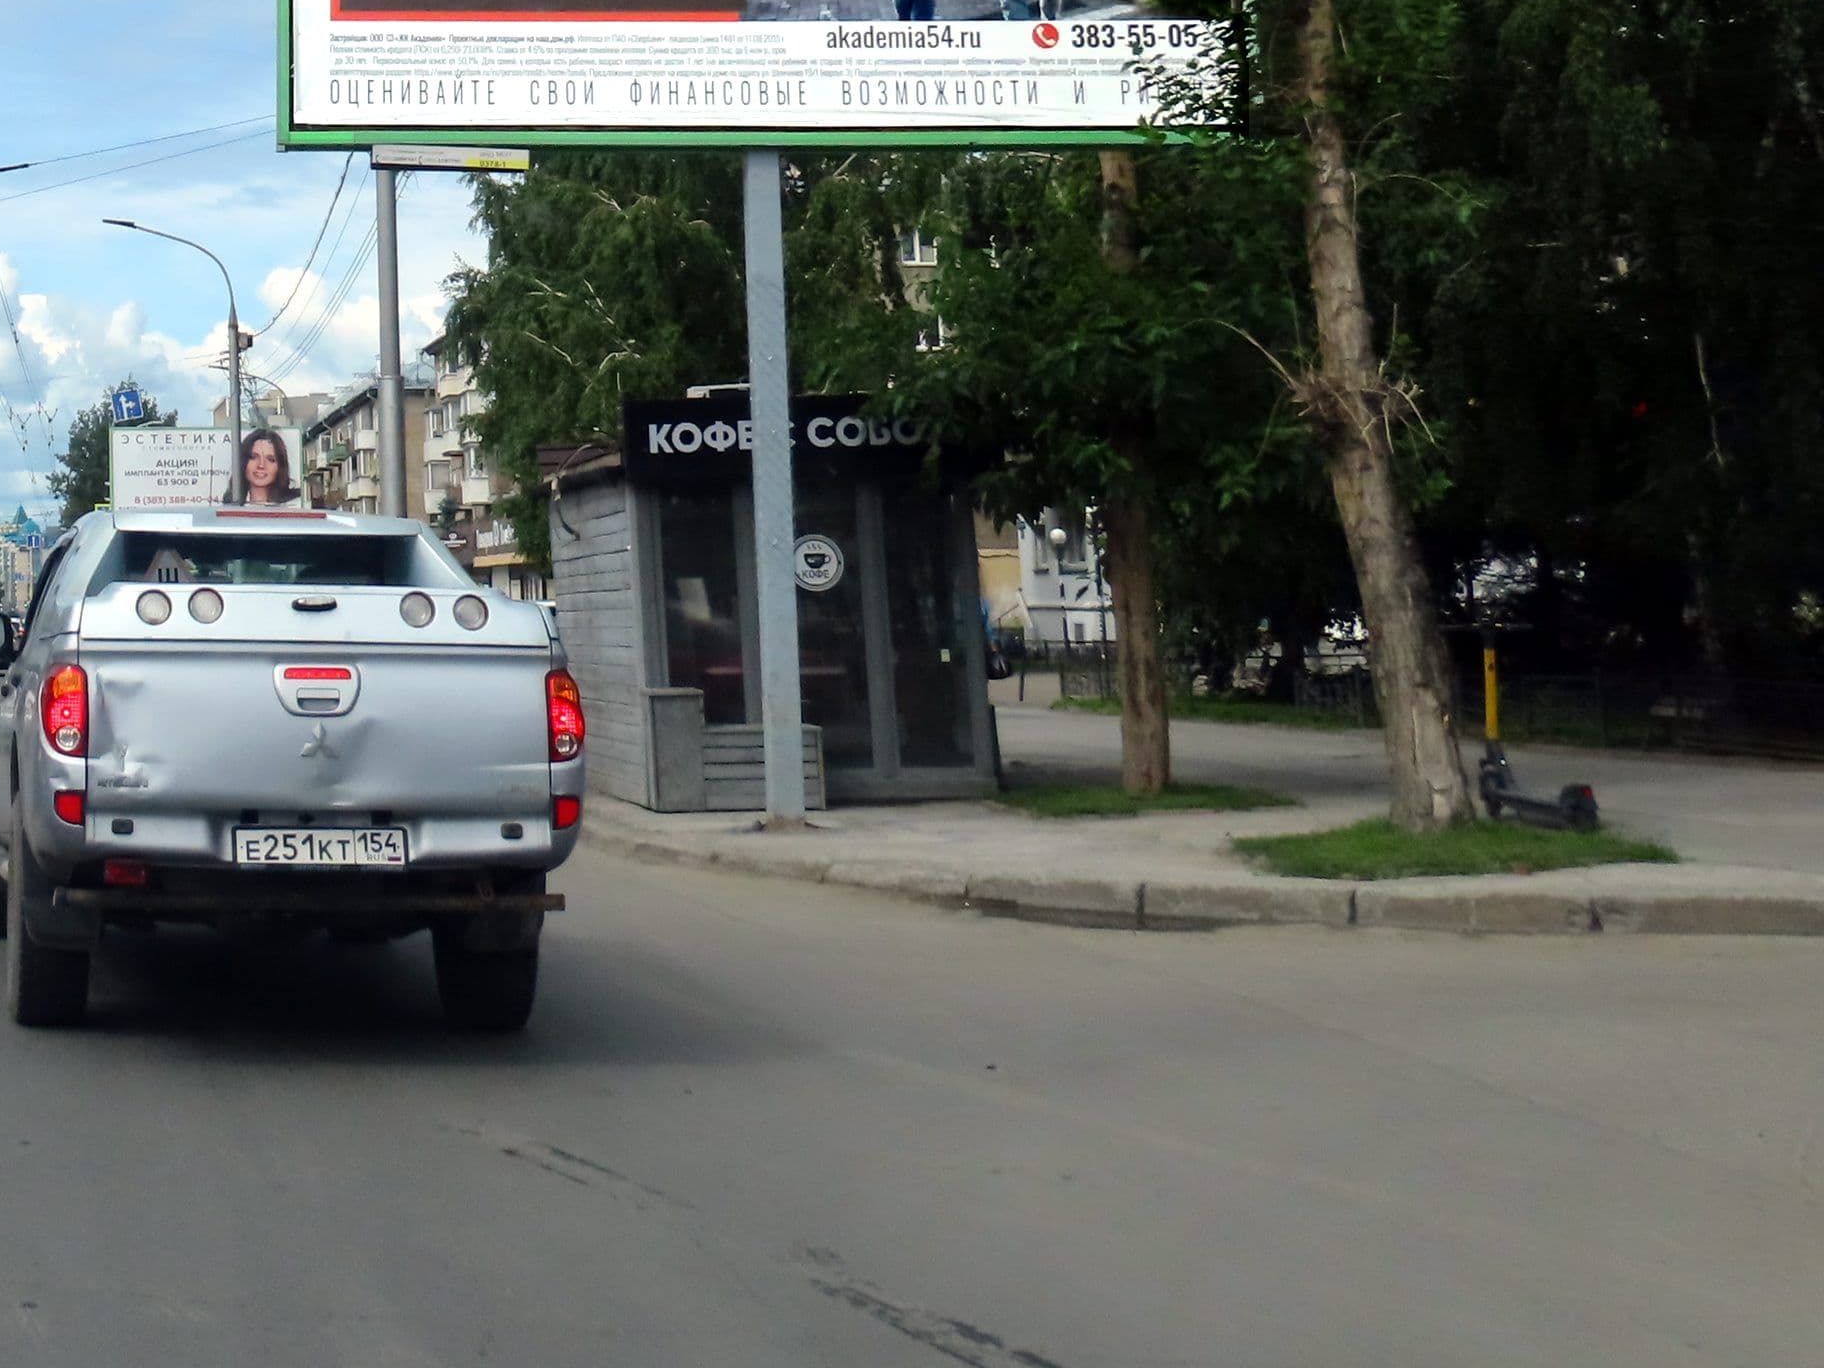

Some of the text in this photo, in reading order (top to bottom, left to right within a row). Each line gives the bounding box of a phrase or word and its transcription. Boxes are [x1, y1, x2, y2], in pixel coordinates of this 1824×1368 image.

[826, 23, 1197, 50] akademia54.ru 383-55-05
[329, 73, 1086, 109] ОЦЕНИВАЙТЕ СВОИ ФИНАНСОВЫЕ ВОЗМОЖНОСТИ И
[121, 433, 232, 445] ЭСТЕТИКА
[648, 419, 753, 454] КОФЕ
[806, 414, 928, 449] СОБО
[155, 459, 198, 469] АКЦИЯ!
[801, 569, 830, 579] КОФЕ
[357, 832, 397, 853] 154
